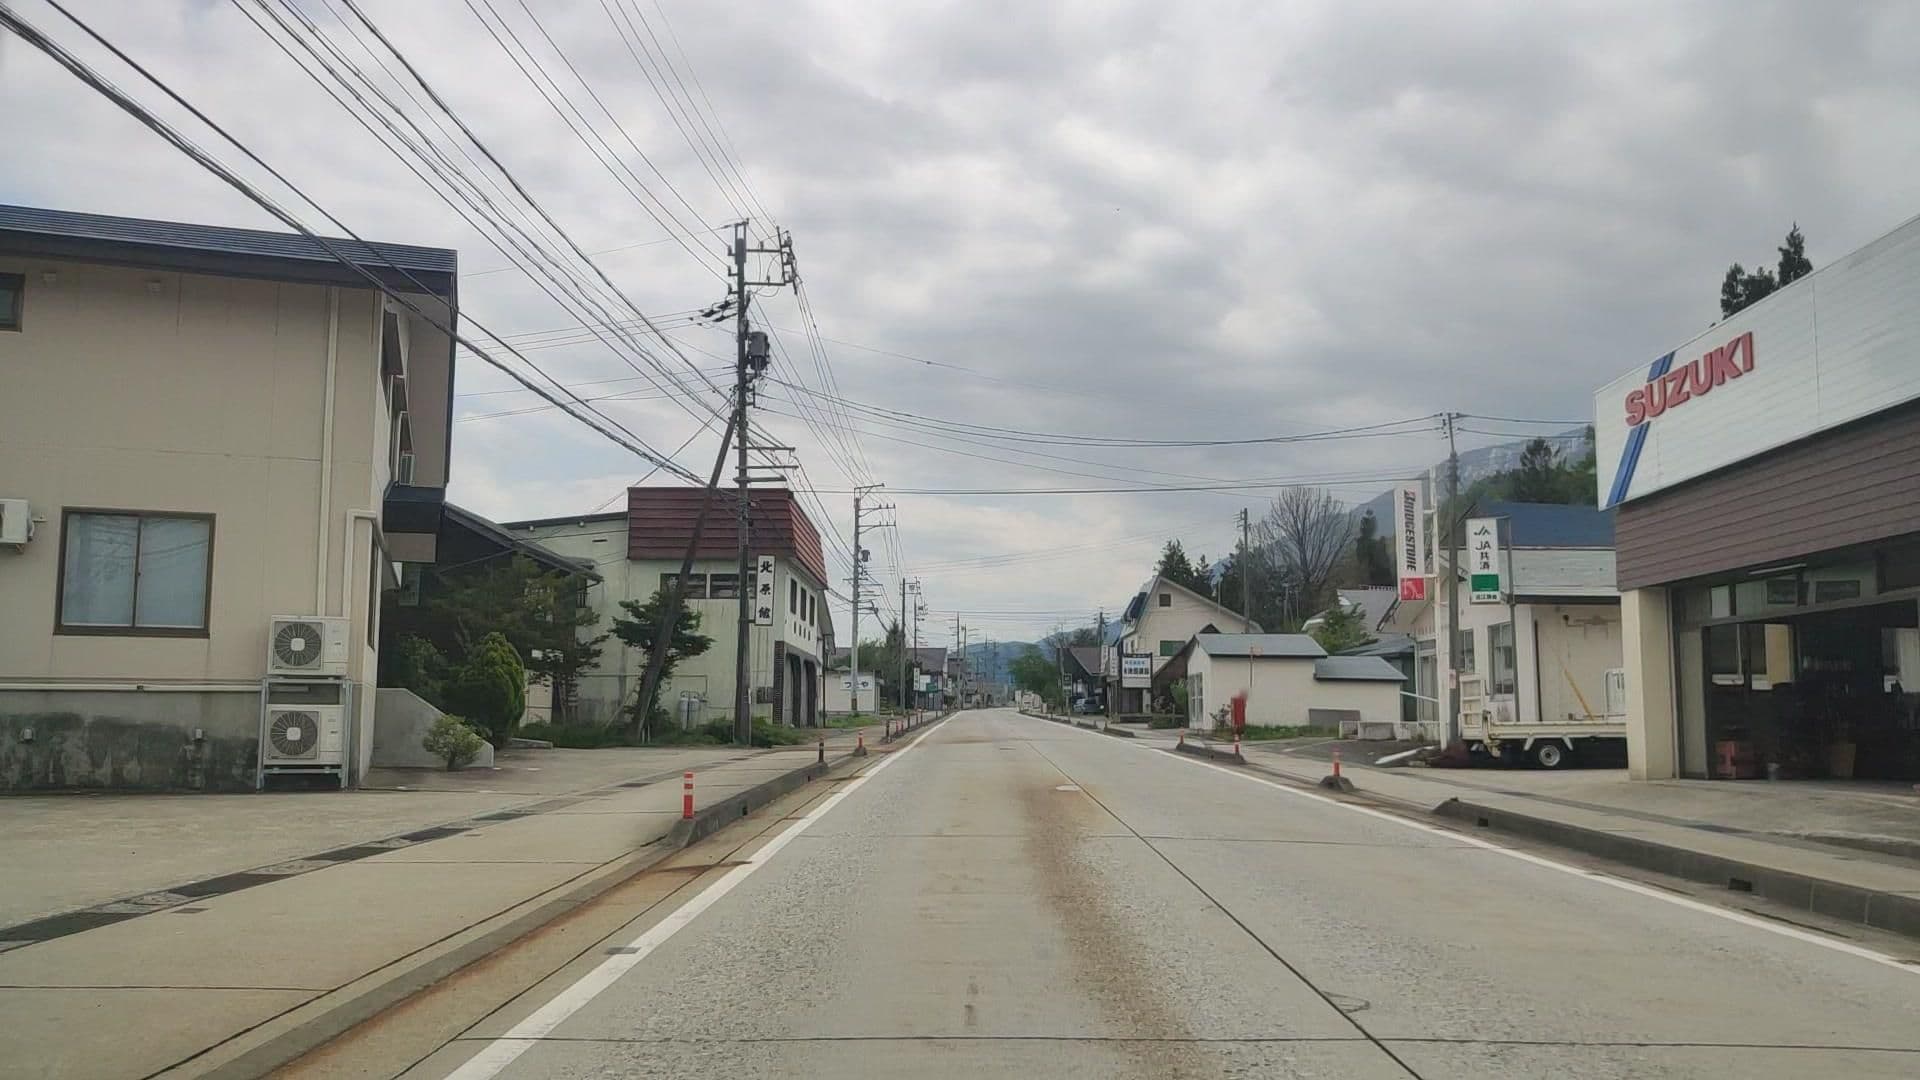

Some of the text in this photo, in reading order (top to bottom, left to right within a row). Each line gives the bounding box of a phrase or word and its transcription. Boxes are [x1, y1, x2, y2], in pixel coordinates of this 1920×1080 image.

[1625, 331, 1755, 427] SUZUKI
[1403, 488, 1417, 572] BRIDGESTONE
[758, 560, 773, 619] 北原館
